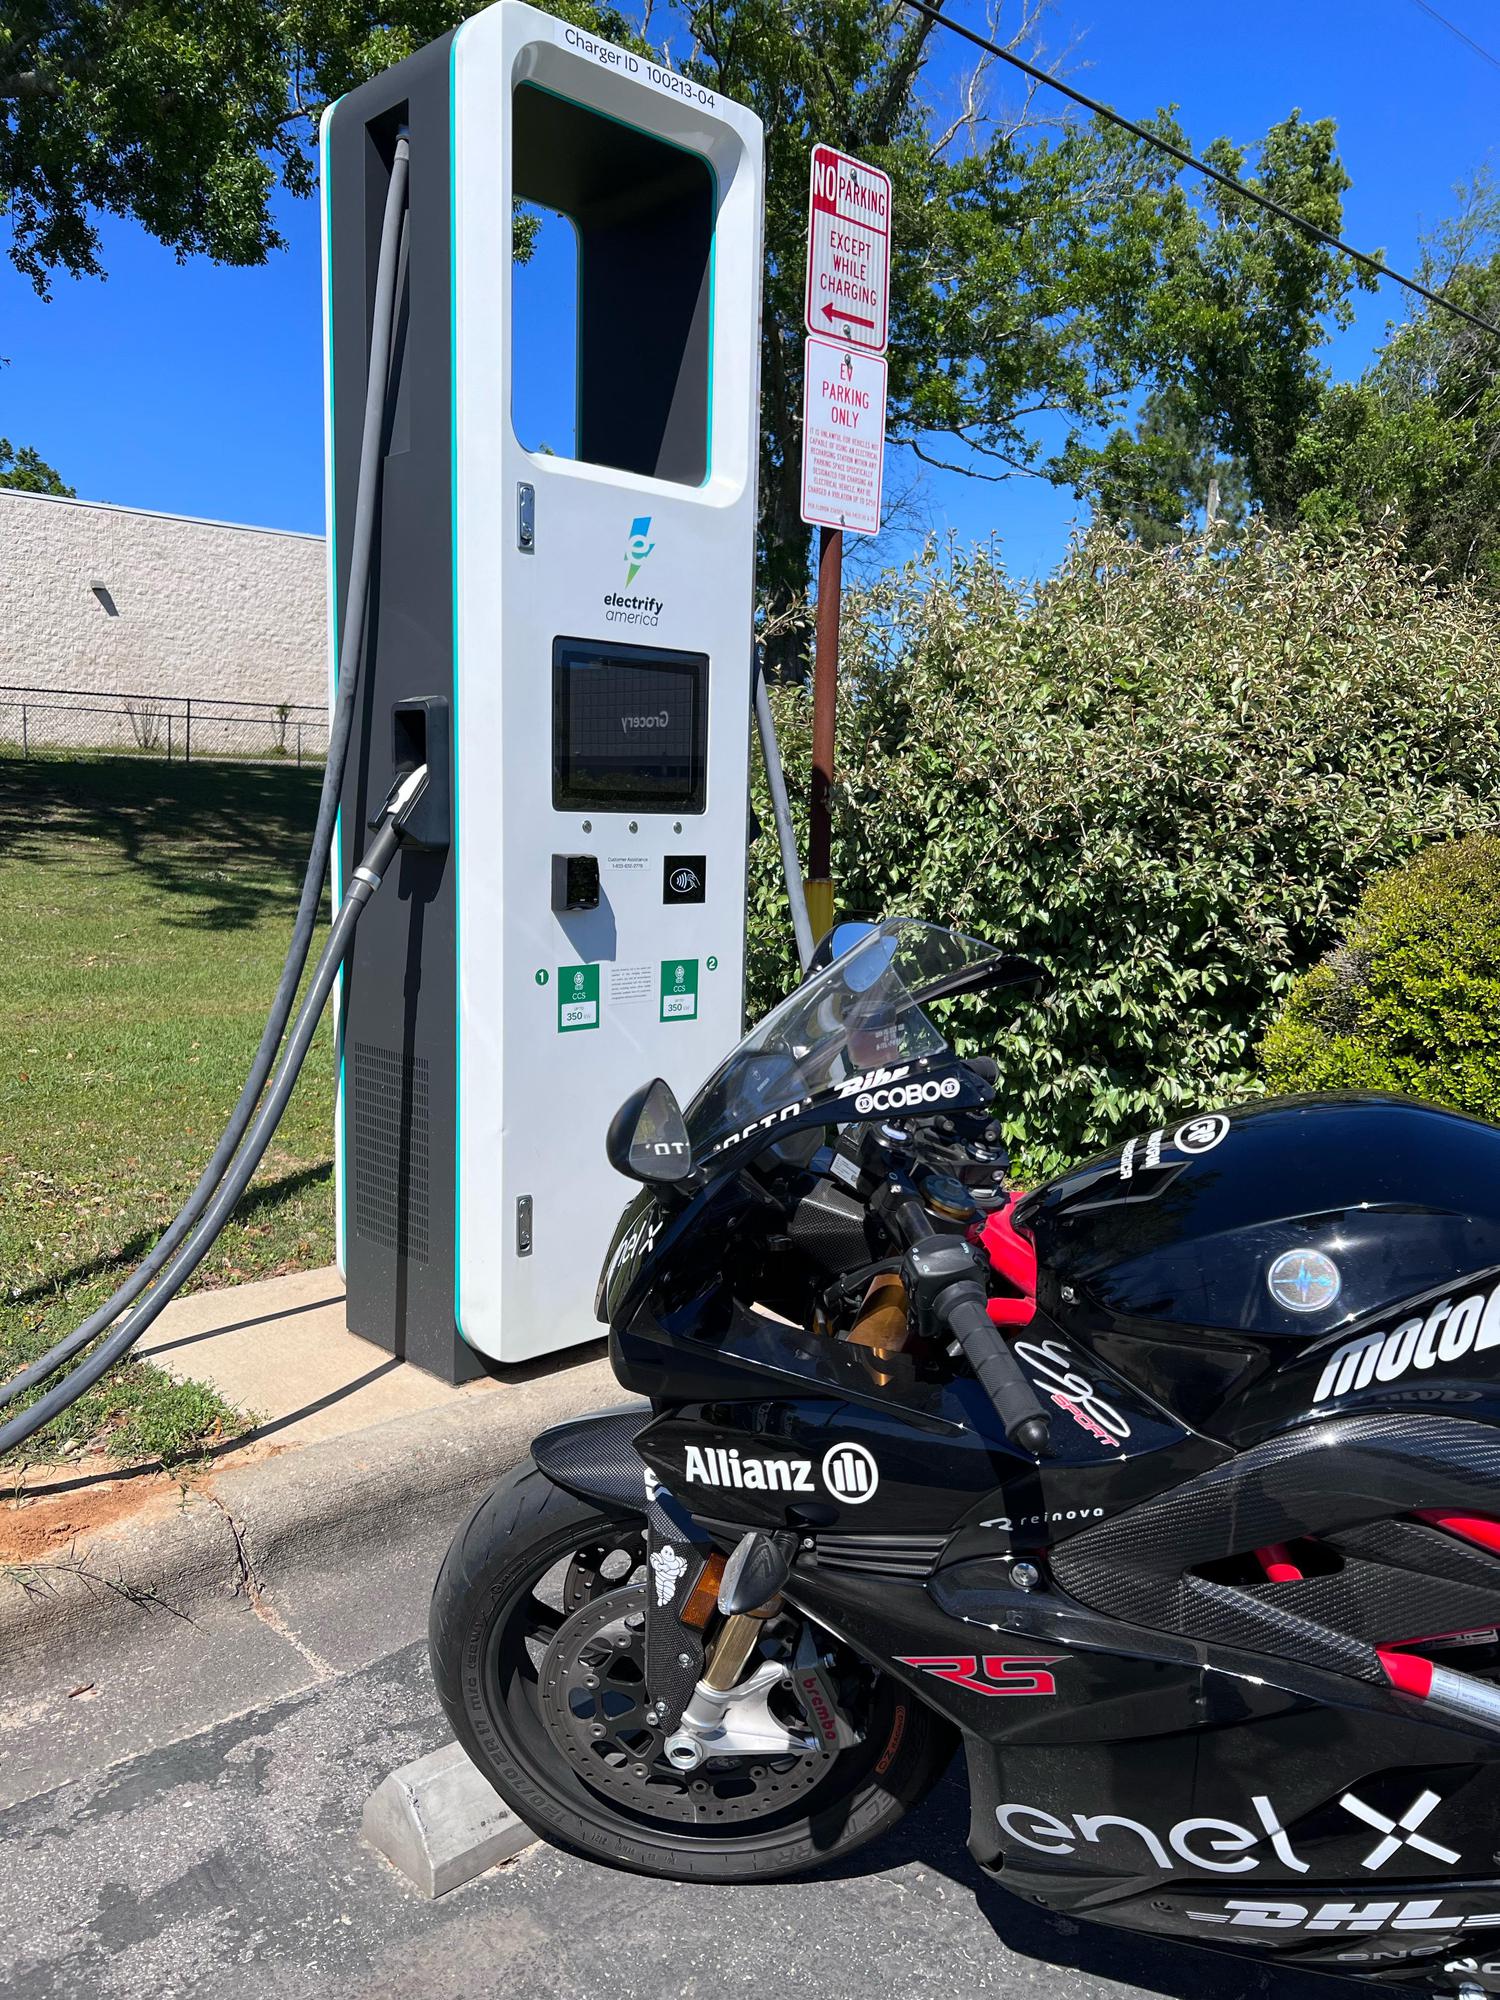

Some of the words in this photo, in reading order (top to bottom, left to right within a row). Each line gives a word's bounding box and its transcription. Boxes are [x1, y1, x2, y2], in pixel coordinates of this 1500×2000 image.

[565, 28, 622, 64] Charger
[624, 53, 639, 73] ID
[646, 65, 716, 109] 100213-04
[814, 160, 837, 202] NO
[838, 176, 885, 217] PARKING
[830, 230, 872, 260] EXCEPT
[833, 253, 867, 281] WHILE
[820, 273, 877, 306] CHARGING
[840, 362, 853, 383] EV
[822, 380, 869, 409] PARKING
[831, 405, 858, 429] ONLY
[603, 592, 664, 615] electrify
[605, 608, 659, 627] america
[572, 992, 586, 1000] CCS
[668, 1003, 683, 1012] 350
[567, 1012, 583, 1021] 350
[873, 1080, 941, 1111] COBO
[1050, 1393, 1120, 1447] SPORT
[684, 1445, 815, 1492] Allianz
[1020, 1507, 1104, 1526] reinova
[892, 1655, 1074, 1697] RS
[802, 1677, 837, 1741] brembo
[995, 1795, 1311, 1875] enel
[1223, 1899, 1465, 1932] DHL
